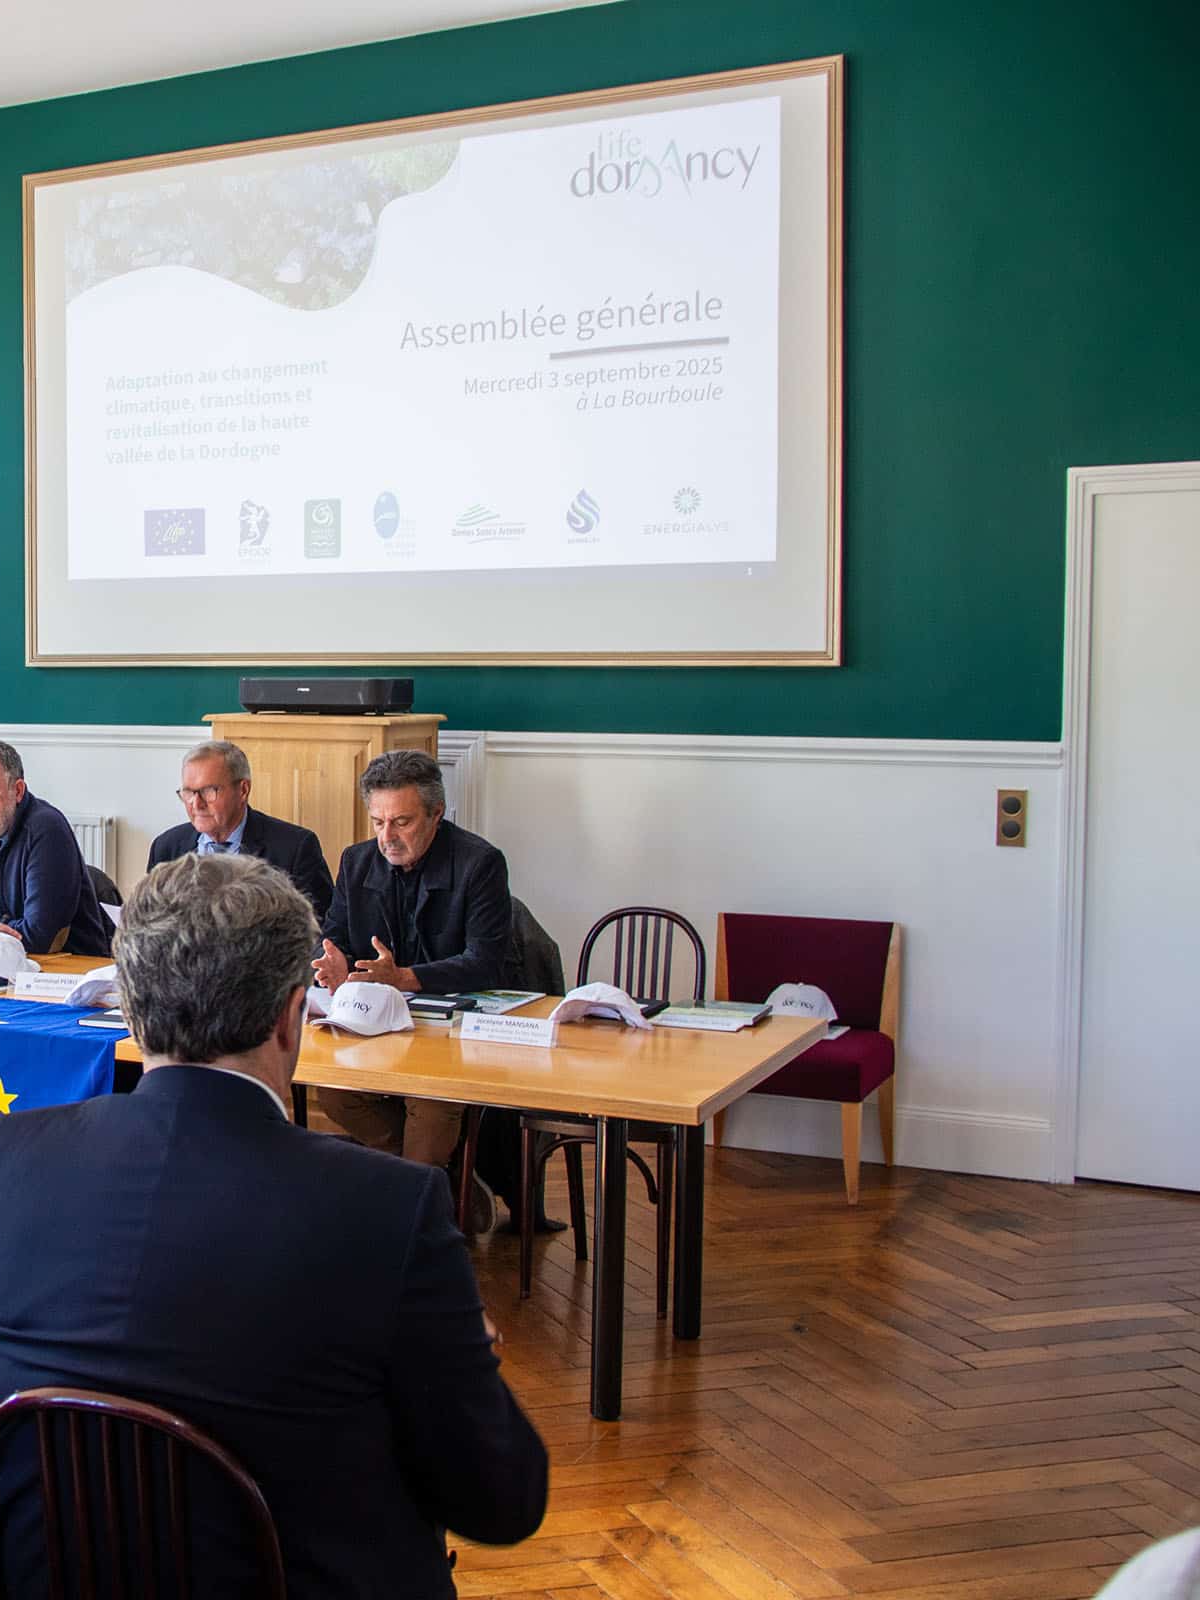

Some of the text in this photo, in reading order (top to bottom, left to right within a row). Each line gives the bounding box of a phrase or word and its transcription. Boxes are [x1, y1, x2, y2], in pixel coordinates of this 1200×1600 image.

[597, 129, 642, 160] life
[399, 290, 724, 351] Assemblée générale
[104, 359, 328, 392] Adaptation au changement
[463, 356, 724, 396] Mercredi 3 septembre 2025
[104, 386, 313, 417] climatique, transitions et
[575, 381, 724, 411] à La Bourboule
[104, 412, 312, 440] revitalisation de la haute
[104, 440, 281, 464] vallée de la Dordogne
